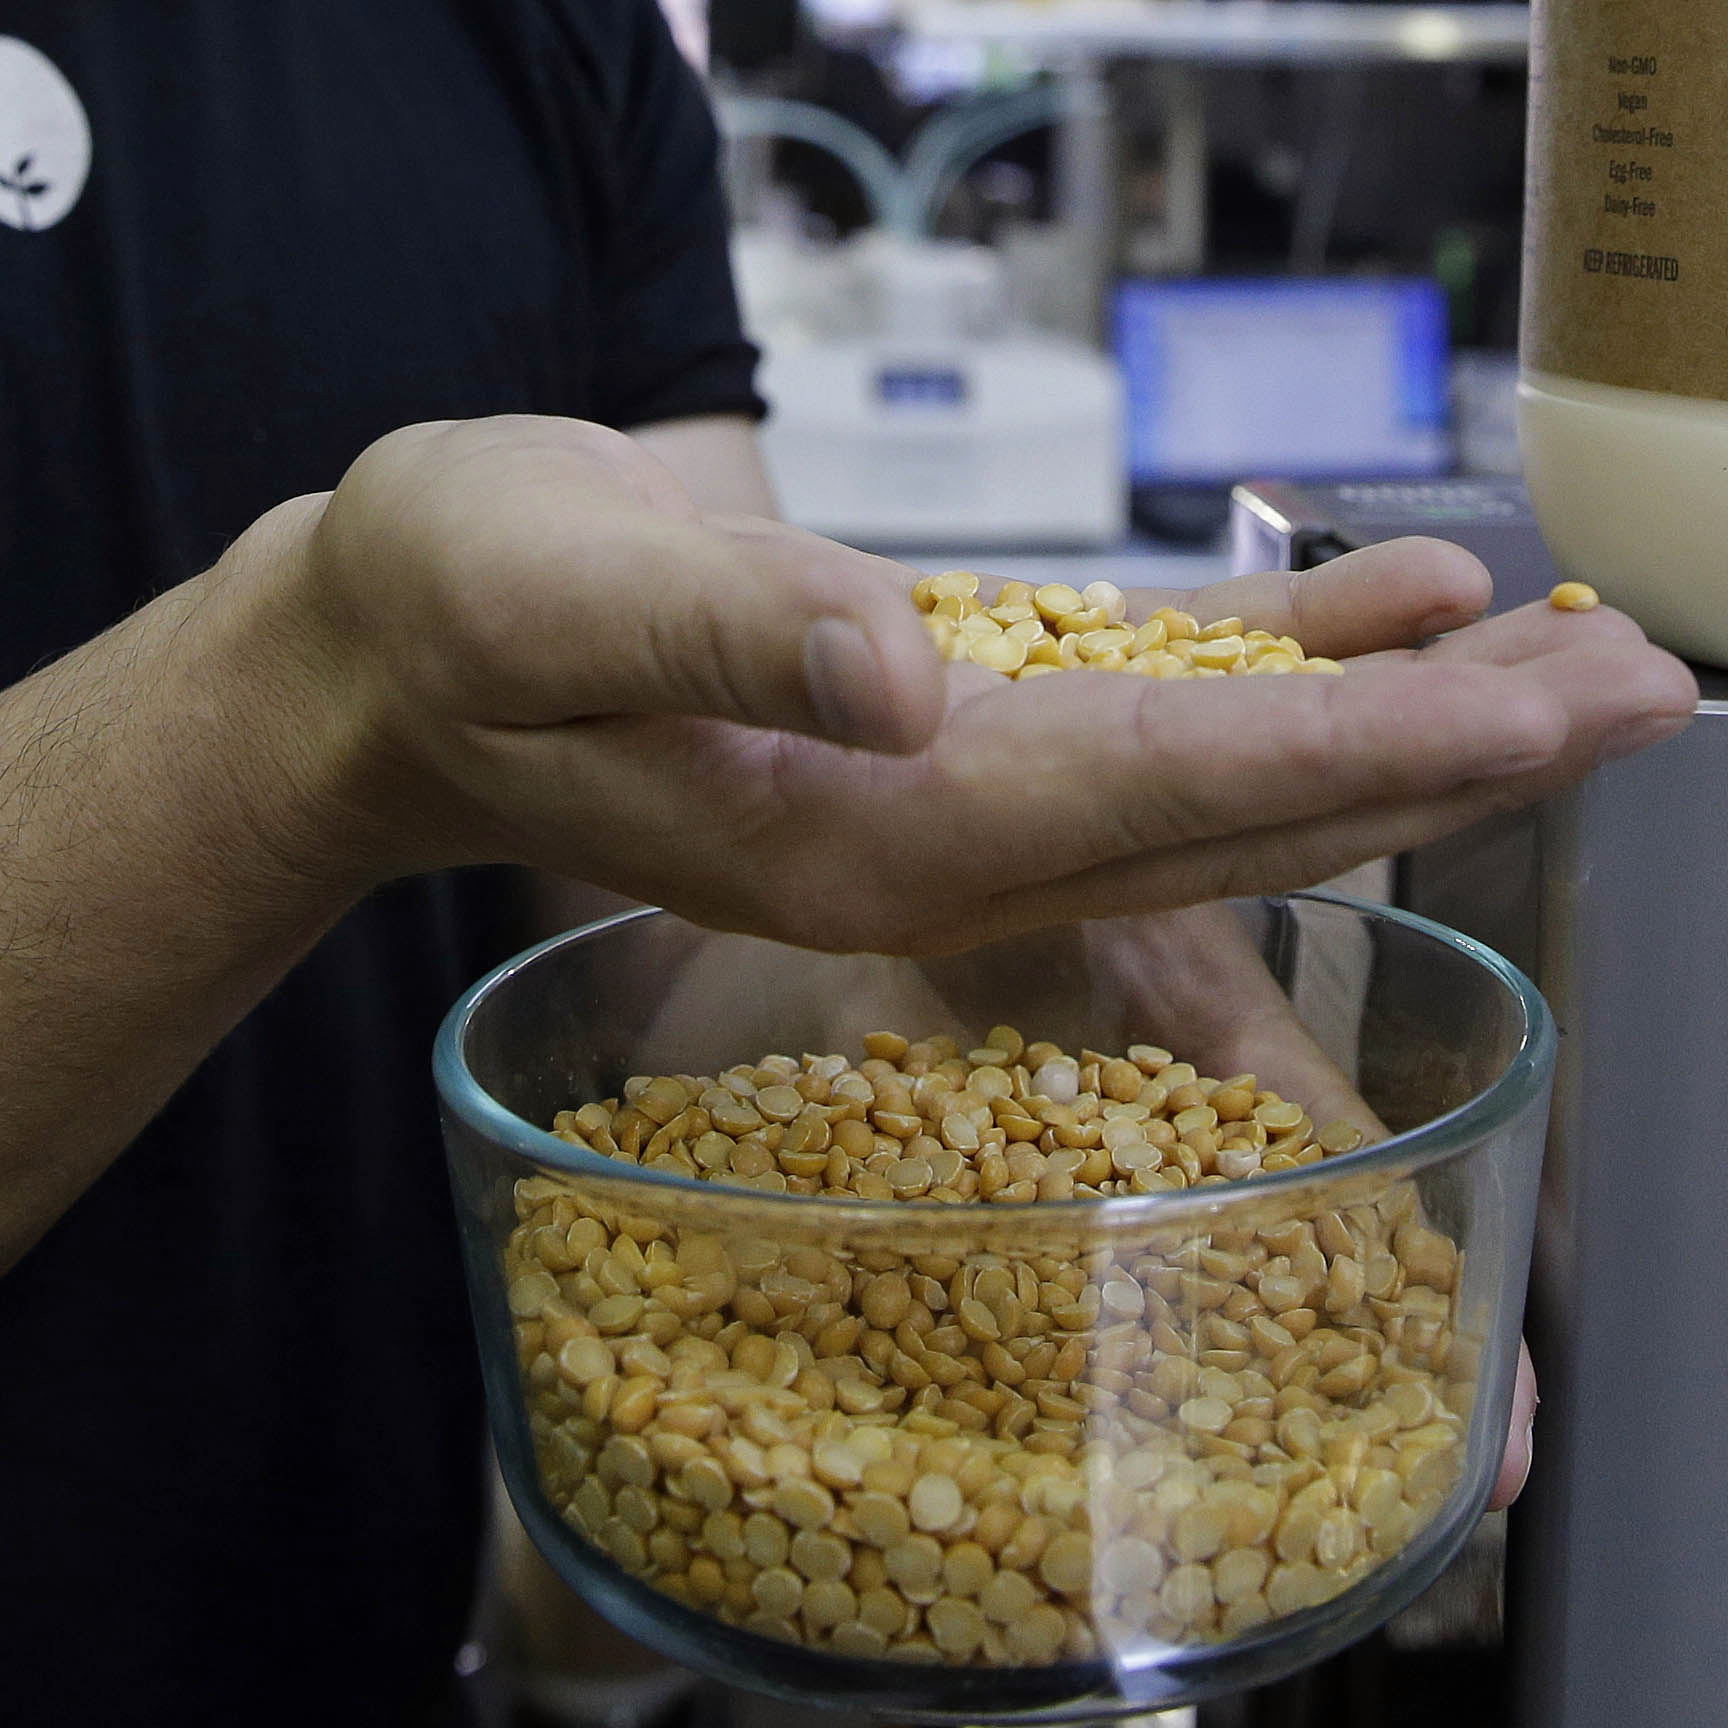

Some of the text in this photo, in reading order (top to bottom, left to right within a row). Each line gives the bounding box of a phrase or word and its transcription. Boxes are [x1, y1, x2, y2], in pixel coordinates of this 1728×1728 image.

[1616, 92, 1648, 114] Vegan
[1592, 123, 1674, 148] Cholesterol-Free
[1609, 160, 1652, 184] Egg-Free
[1604, 194, 1657, 218] Dairy-Free
[1605, 252, 1680, 282] REFRIGERATED
